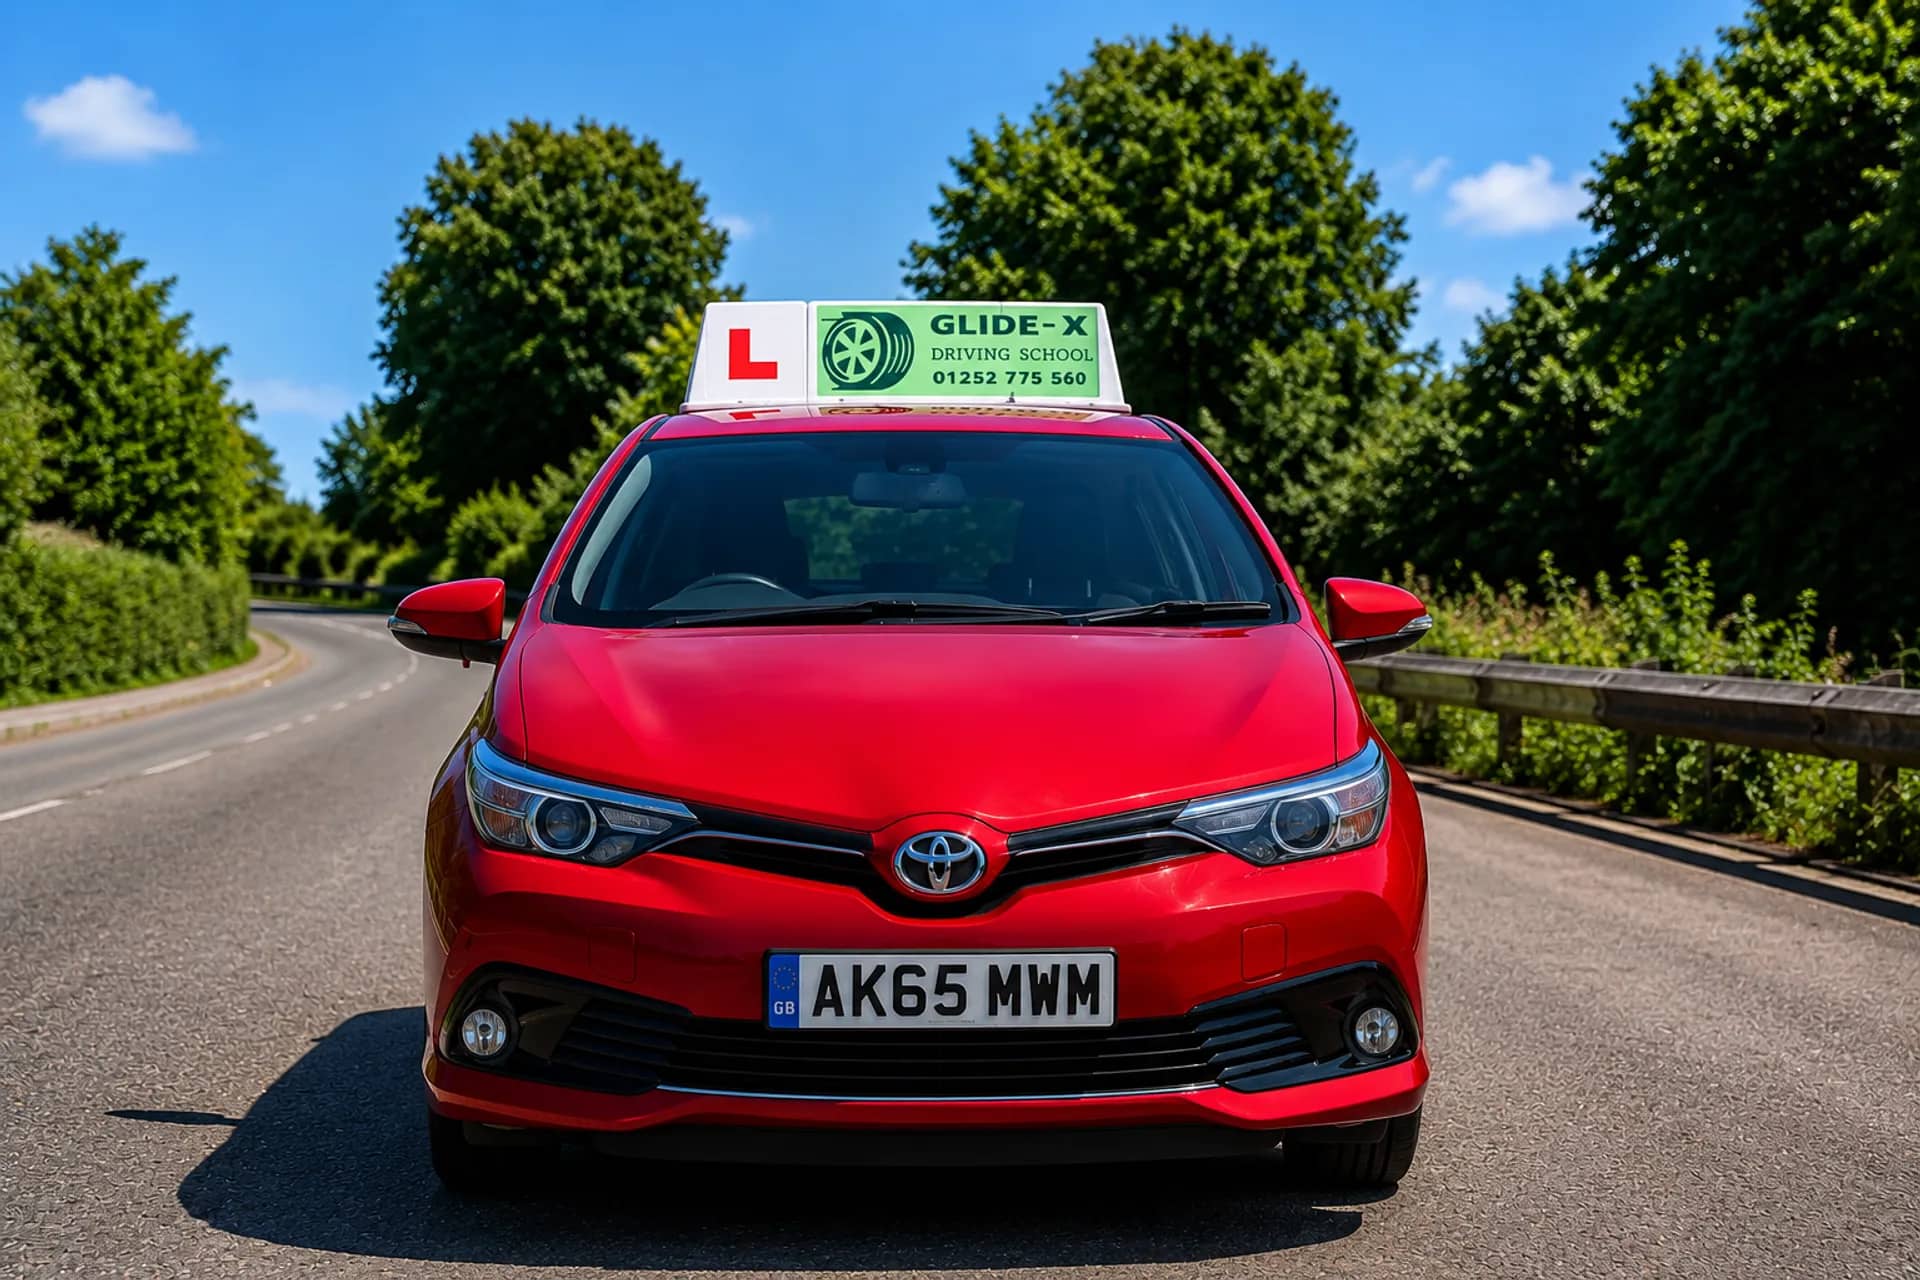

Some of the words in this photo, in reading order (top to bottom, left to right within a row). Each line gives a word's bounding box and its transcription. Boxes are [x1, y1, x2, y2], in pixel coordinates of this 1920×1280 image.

[930, 313, 1089, 336] GLIDE-X
[729, 328, 778, 380] L
[931, 347, 1010, 362] DRIVING
[1019, 347, 1094, 362] SCHOOL
[932, 371, 997, 385] 01252
[1005, 371, 1042, 385] 775
[1051, 371, 1087, 385] 560
[811, 963, 968, 1017] AK65
[988, 963, 1100, 1017] MWM
[773, 1001, 796, 1015] GB
